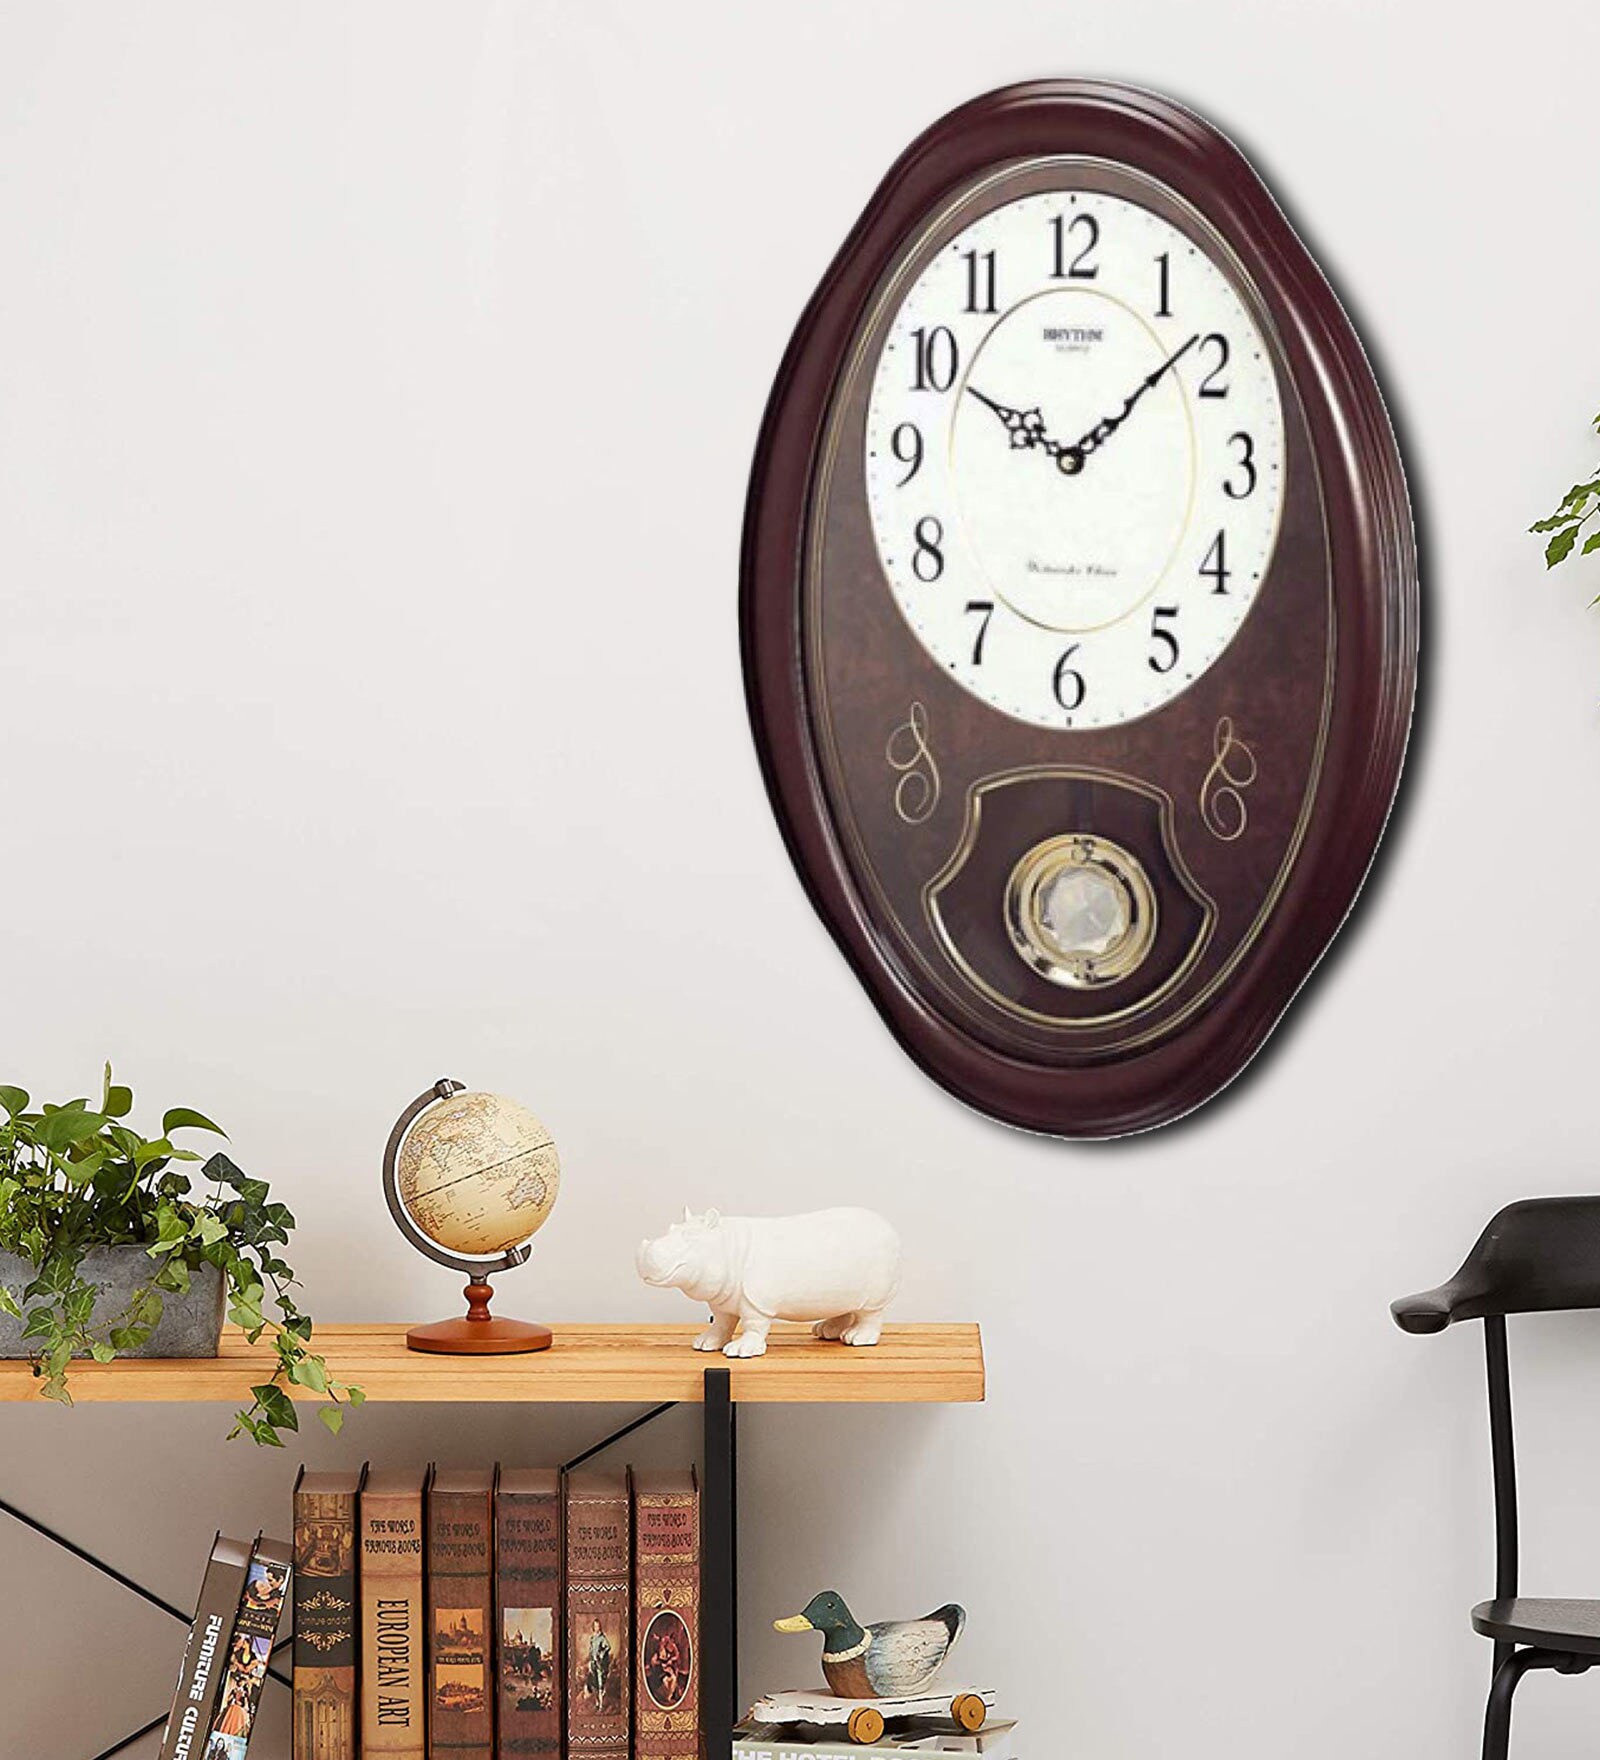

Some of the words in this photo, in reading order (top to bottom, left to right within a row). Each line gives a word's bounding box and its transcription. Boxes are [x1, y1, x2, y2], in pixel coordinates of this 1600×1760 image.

[1049, 213, 1100, 280] 12
[961, 249, 999, 315] 11
[1152, 252, 1173, 318] 1
[909, 325, 960, 393] 10
[1198, 332, 1230, 400] 2
[889, 423, 924, 488] 9
[1221, 430, 1257, 500] 3
[910, 516, 945, 583] 8
[1197, 528, 1232, 596] 4
[963, 600, 995, 666] 7
[1147, 606, 1180, 674] 5
[1051, 643, 1087, 711] 6
[189, 1614, 223, 1701] FURNITURE
[376, 1599, 410, 1688] EUROPEAN
[377, 1695, 410, 1727] ART
